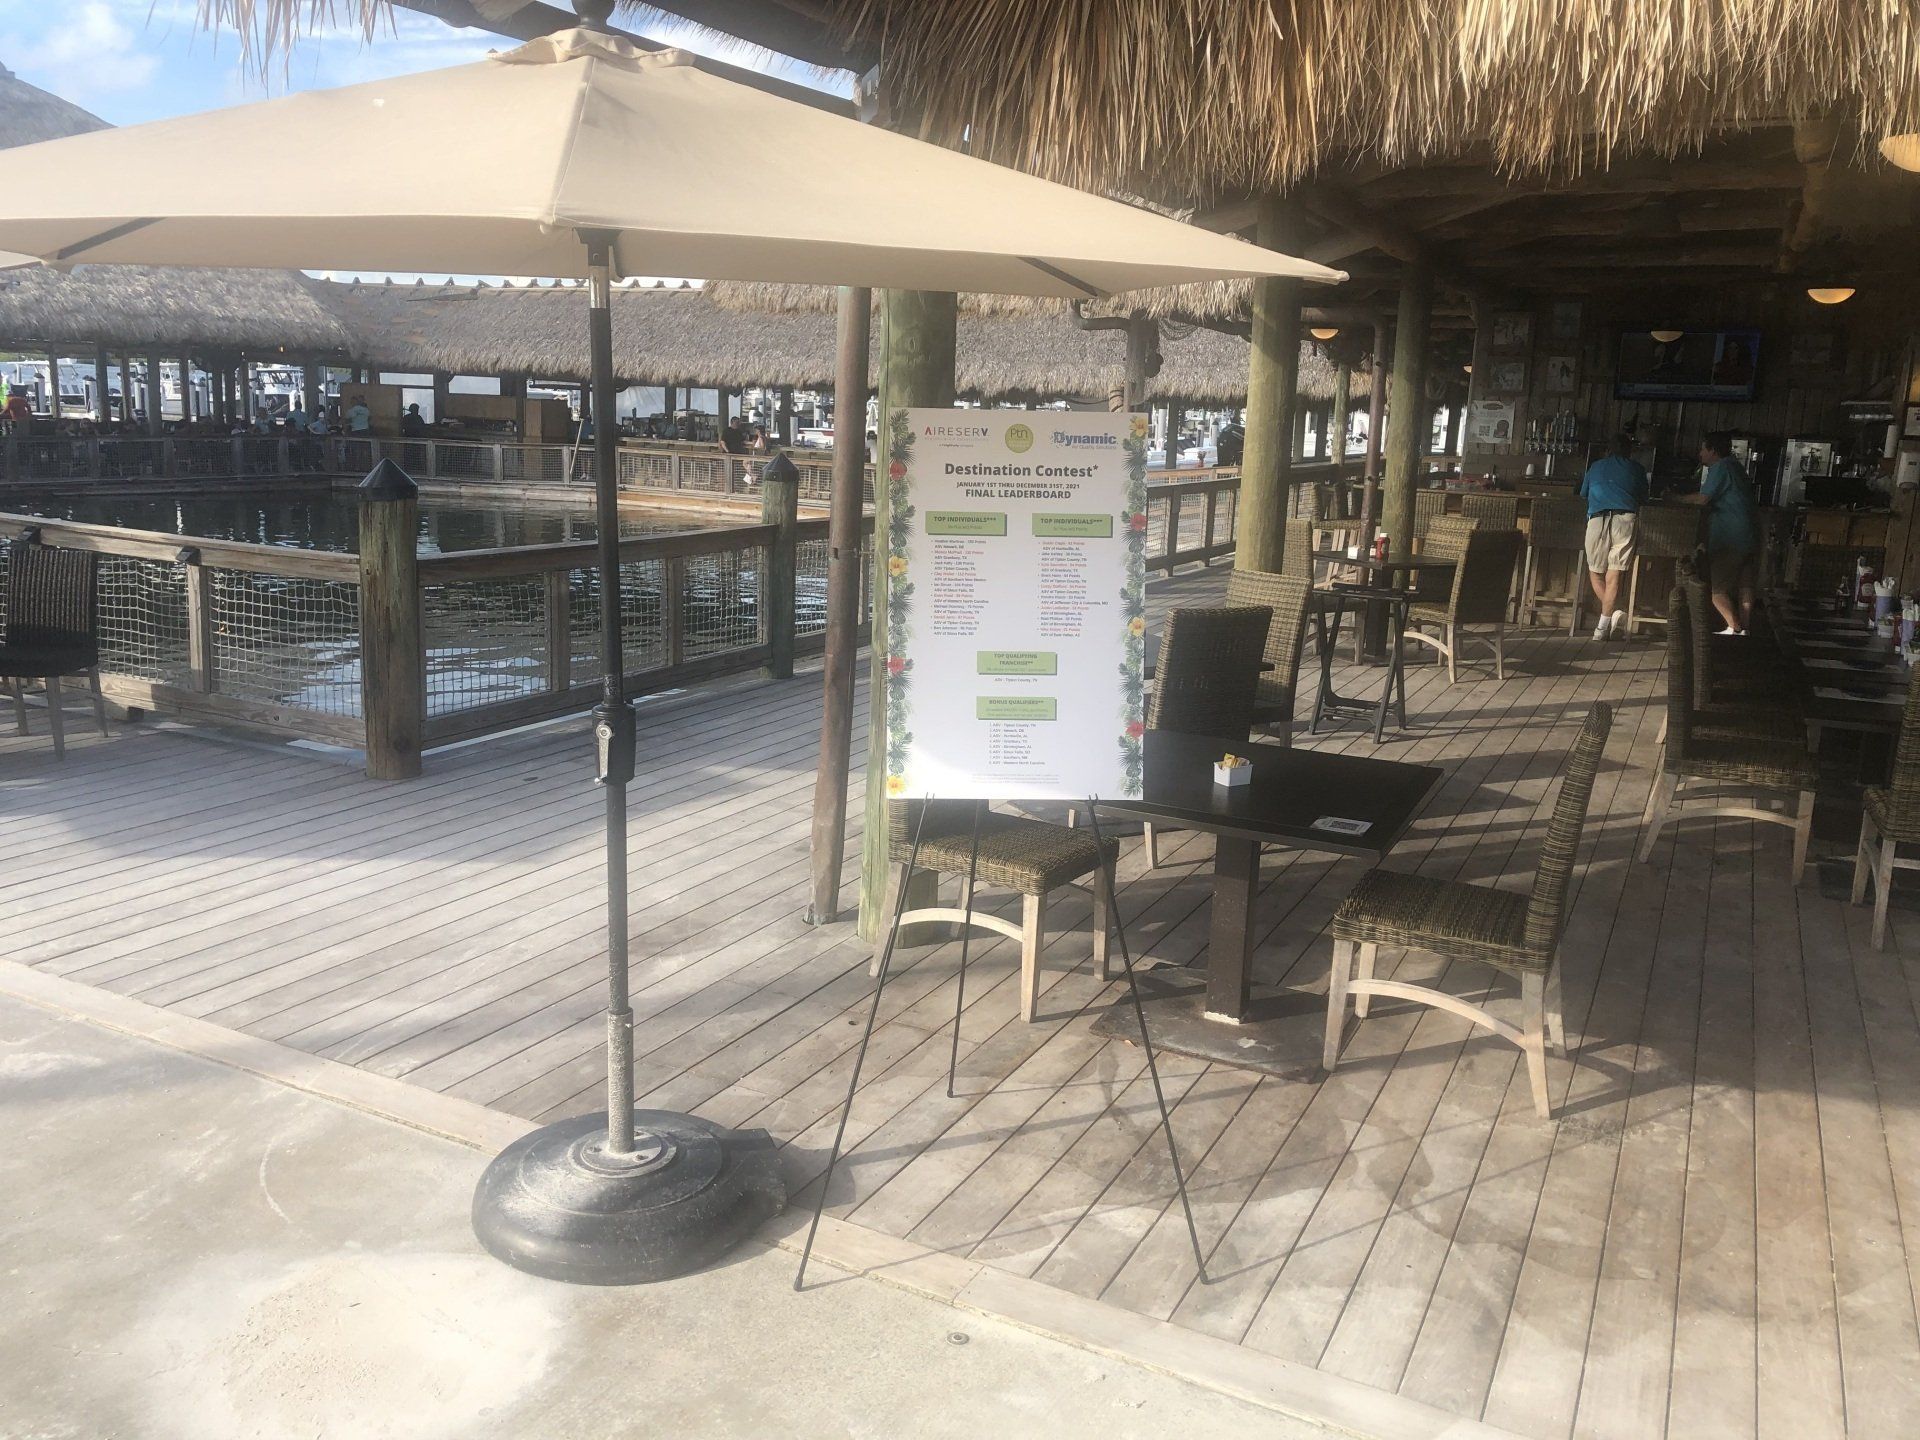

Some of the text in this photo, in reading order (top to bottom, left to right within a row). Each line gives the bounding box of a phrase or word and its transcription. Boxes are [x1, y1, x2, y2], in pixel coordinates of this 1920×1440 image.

[944, 463, 1031, 476] Destination
[965, 489, 1071, 499] FINAL LEADERBOARD
